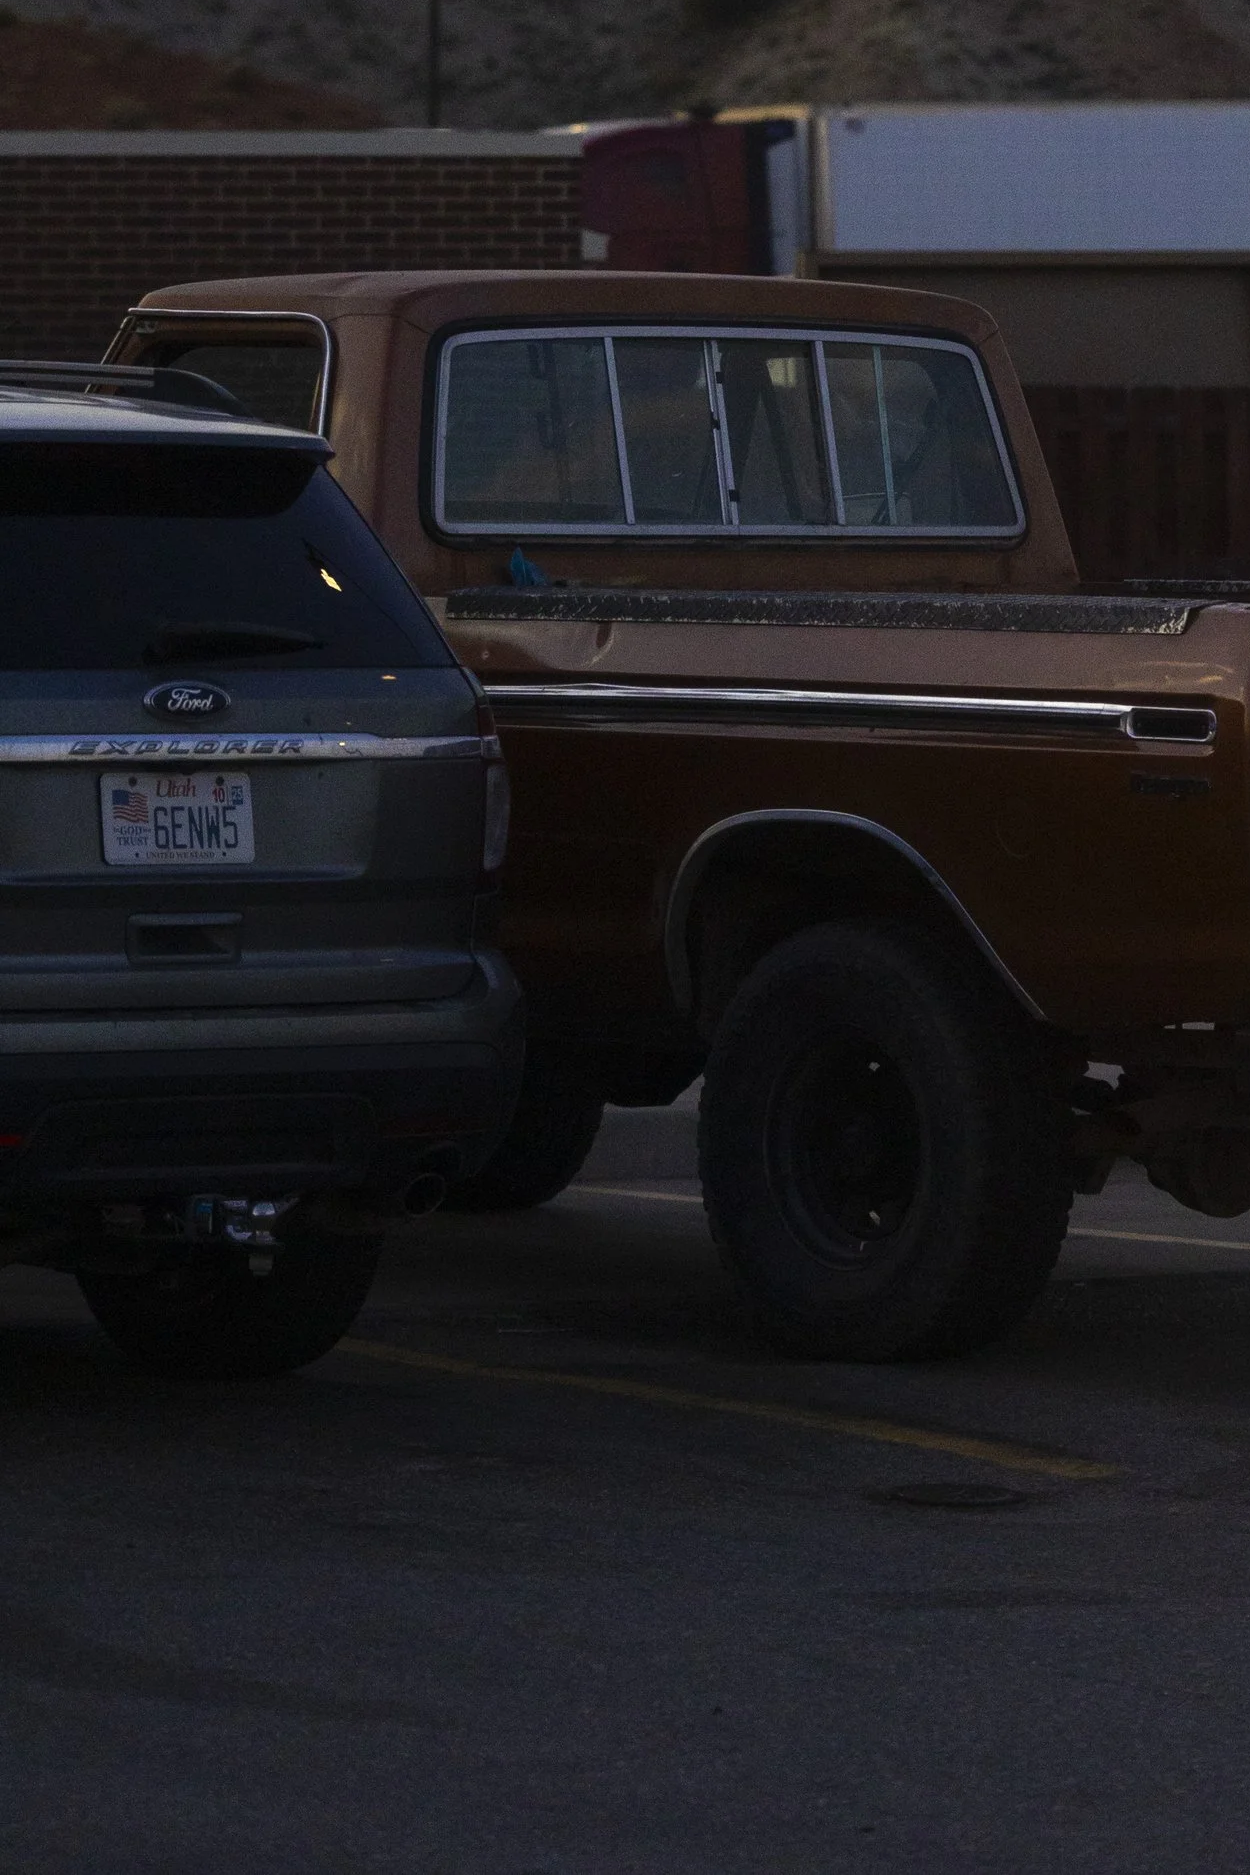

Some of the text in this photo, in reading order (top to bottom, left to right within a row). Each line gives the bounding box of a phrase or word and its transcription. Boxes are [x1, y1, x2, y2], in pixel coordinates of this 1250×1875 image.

[167, 687, 214, 712] Ford
[69, 738, 304, 755] EXPLORER
[156, 778, 196, 797] Utah
[212, 787, 226, 803] 10
[119, 825, 142, 835] GOD
[154, 805, 239, 850] 6ENW5
